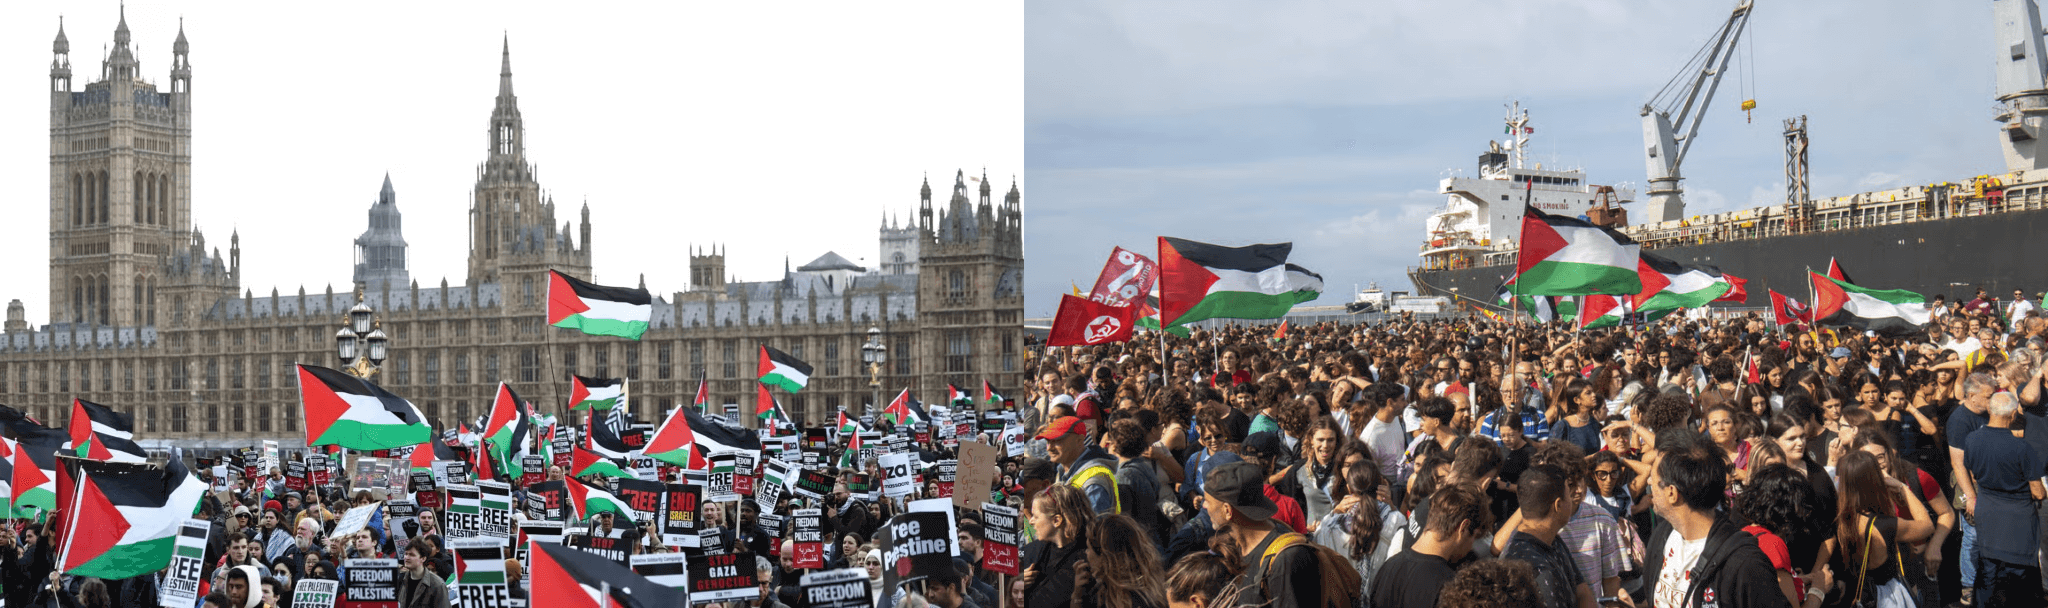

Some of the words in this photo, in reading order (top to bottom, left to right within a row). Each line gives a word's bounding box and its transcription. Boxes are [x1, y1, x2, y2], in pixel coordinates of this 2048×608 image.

[622, 434, 644, 447] FREE
[885, 464, 907, 479] za
[708, 473, 732, 486] FRE
[708, 484, 732, 493] PALESTI
[670, 492, 695, 511] END
[447, 512, 479, 530] FREE
[481, 508, 508, 526] REE
[670, 511, 693, 521] ISRAELI
[759, 518, 780, 527] FREEDOM
[796, 517, 819, 527] FREEDOM
[985, 512, 1014, 528] FREEDOM
[447, 528, 479, 538] PALESTINE
[795, 532, 821, 542] PALESTINE
[891, 520, 920, 544] ree
[985, 528, 1016, 544] PALESTINE
[591, 538, 614, 548] STOP
[799, 545, 815, 554] الحرية
[709, 555, 736, 566] STOP
[797, 555, 818, 564] لفلسطين
[350, 569, 392, 582] FREEDOM
[709, 565, 737, 578] GAZA
[297, 582, 307, 591] FREE
[308, 581, 334, 592] PALESTINE
[697, 576, 752, 590] GENOCIDE
[295, 593, 332, 604] EXIST!
[348, 588, 396, 600] PALESTINE
[459, 585, 508, 608] FREE
[808, 581, 865, 603] FREEDOM
